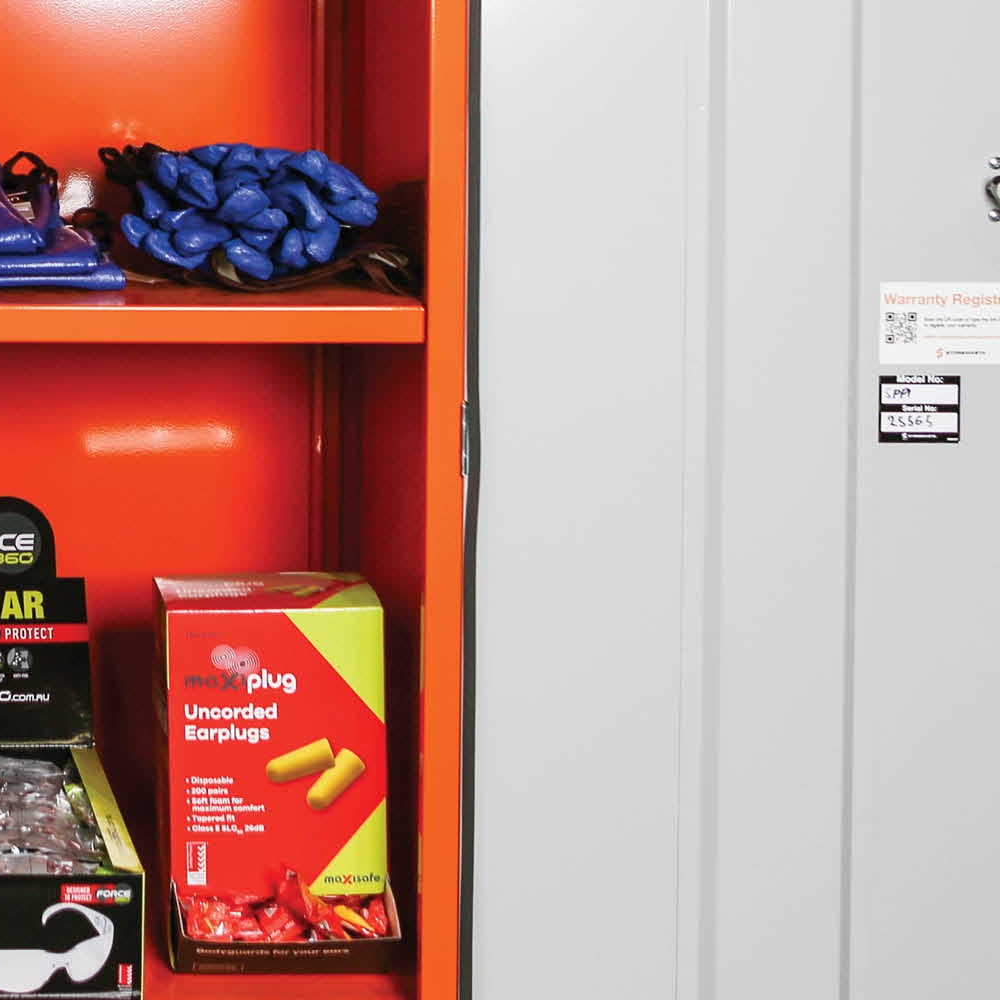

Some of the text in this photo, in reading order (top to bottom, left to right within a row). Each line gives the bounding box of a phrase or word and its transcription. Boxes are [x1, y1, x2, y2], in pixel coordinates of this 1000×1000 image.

[884, 293, 948, 307] Warranty
[896, 374, 925, 383] Model
[4, 627, 54, 640] PROTECT
[183, 702, 278, 721] Uncorded
[184, 723, 270, 744] Earplugs
[191, 776, 234, 786] Disposable
[208, 786, 229, 796] pairs
[191, 804, 265, 812] maximum comfort
[192, 814, 225, 823] Tapered
[191, 824, 214, 832] Class
[96, 889, 131, 898] FORCE
